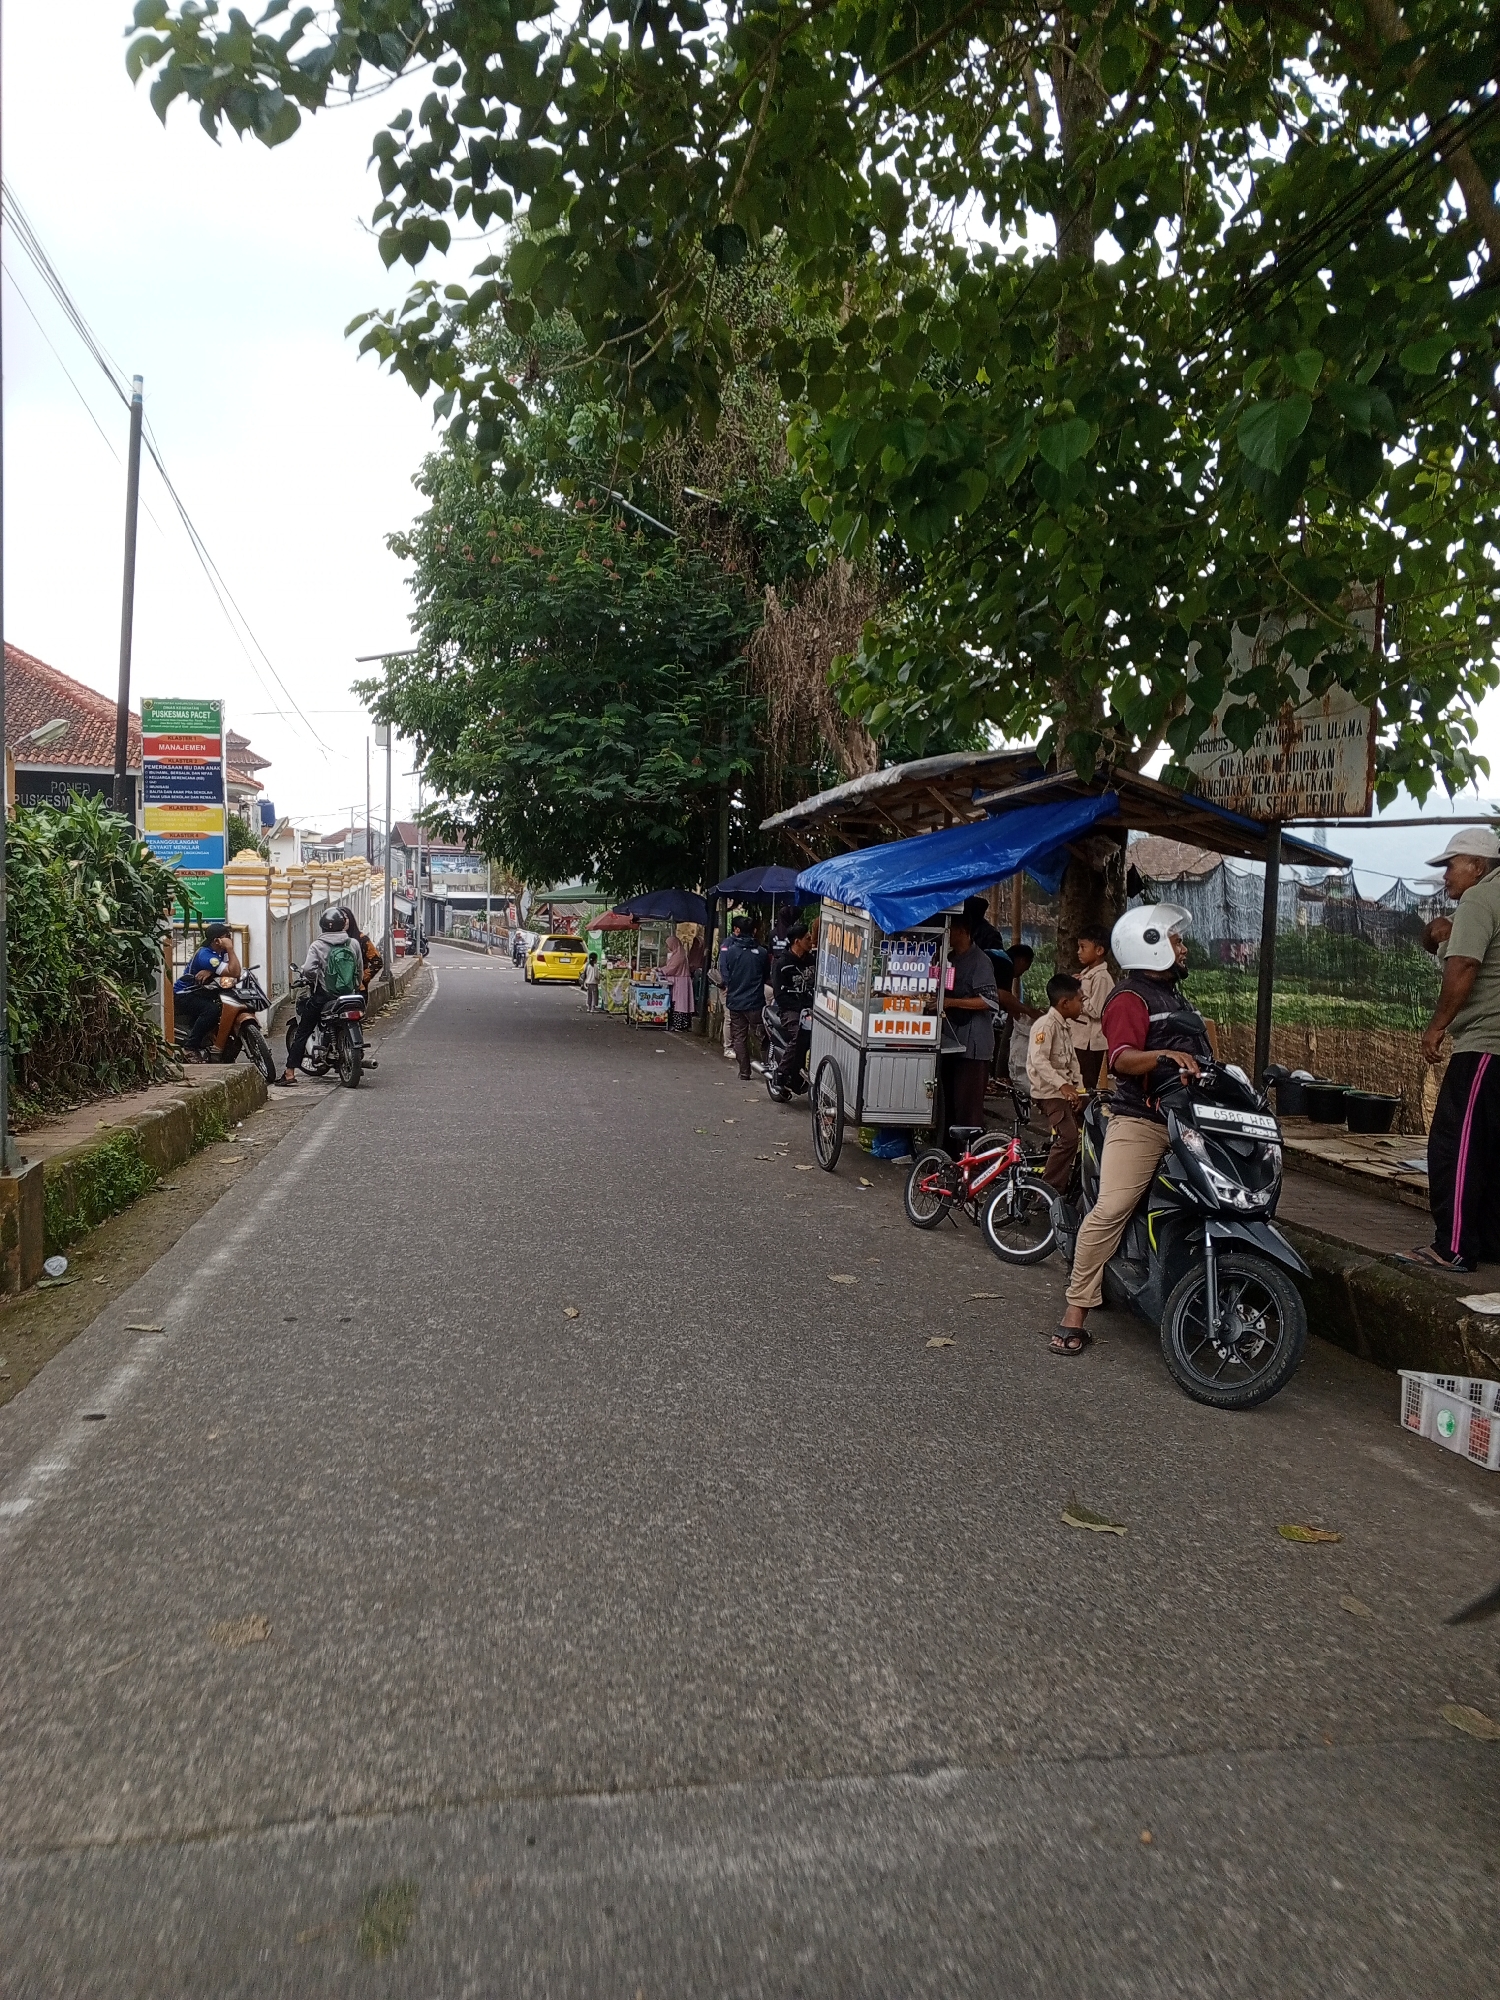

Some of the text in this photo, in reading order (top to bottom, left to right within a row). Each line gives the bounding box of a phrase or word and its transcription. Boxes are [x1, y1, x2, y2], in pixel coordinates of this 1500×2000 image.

[152, 710, 211, 719] PUSKESMAS PACET
[1192, 736, 1229, 754] NGURUS
[1327, 719, 1363, 739] ULAMA
[1219, 749, 1335, 777] DILARANG MENDIRIKAN
[14, 793, 76, 807] PUSKESM
[1305, 792, 1348, 813] PEMILIK
[879, 939, 937, 958] SIOMAY
[887, 961, 925, 973] 10.000
[873, 976, 938, 993] BATAGOR
[874, 1019, 932, 1036] KERING
[1196, 1106, 1203, 1116] F
[1179, 1182, 1199, 1204] HONDA
